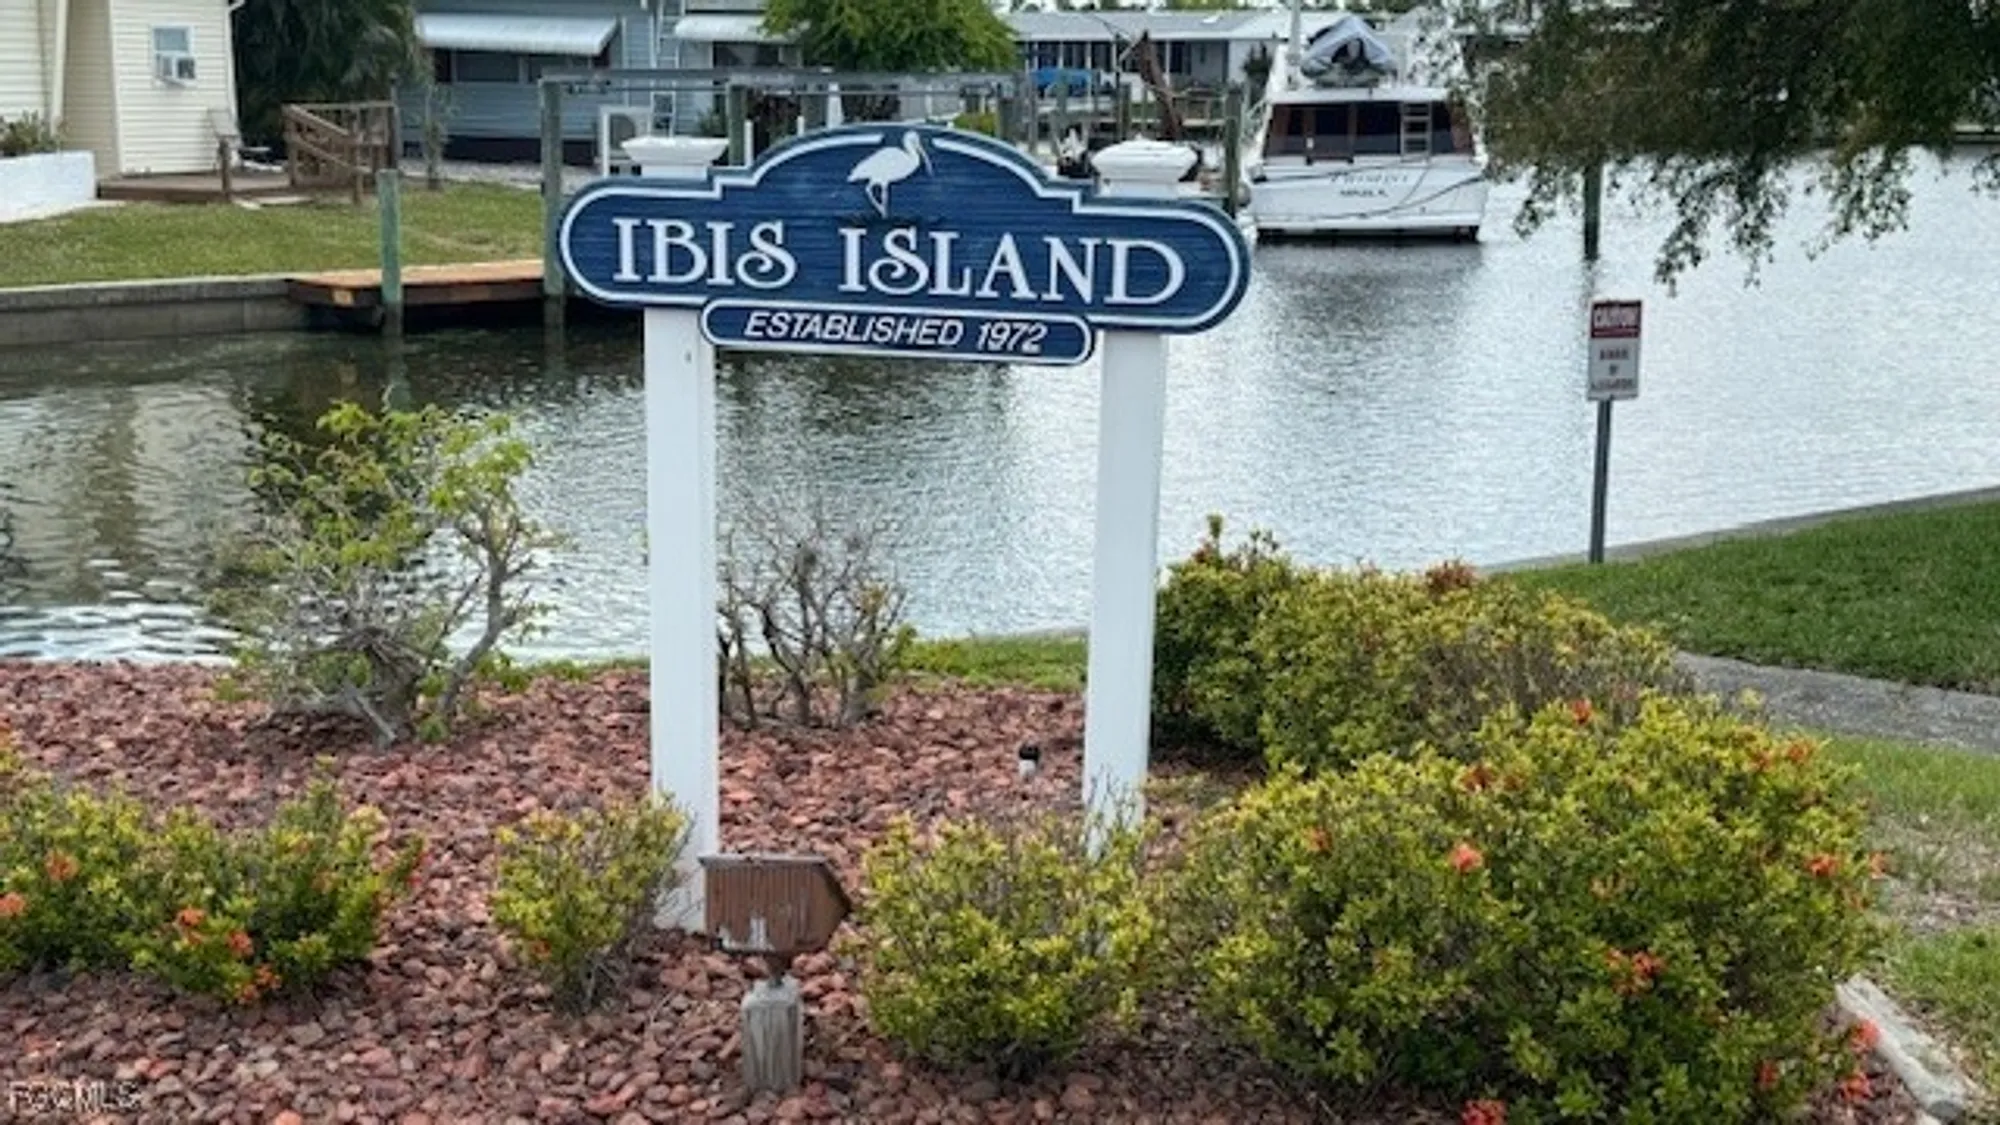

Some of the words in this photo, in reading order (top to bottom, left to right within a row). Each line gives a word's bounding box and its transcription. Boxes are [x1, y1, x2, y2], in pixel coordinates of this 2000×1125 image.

[612, 217, 796, 288] IBIS
[838, 226, 1185, 304] ISLAND
[745, 311, 964, 345] ESTABLISHED
[977, 322, 1047, 353] 1972
